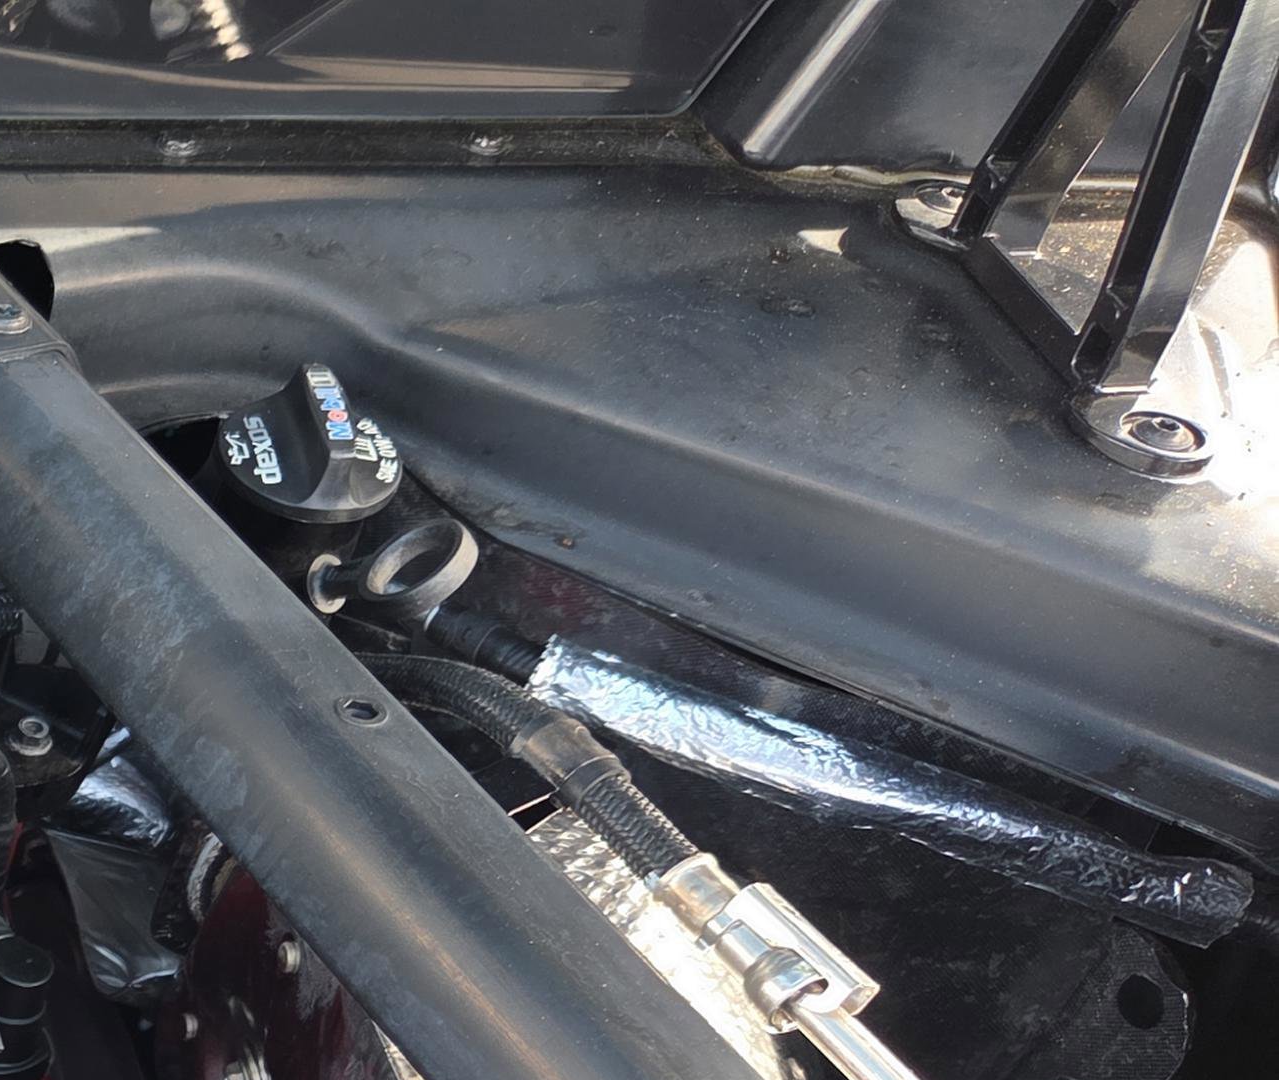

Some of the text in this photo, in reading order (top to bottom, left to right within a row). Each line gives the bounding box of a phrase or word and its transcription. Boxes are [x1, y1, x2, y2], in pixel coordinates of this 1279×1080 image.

[313, 386, 354, 440] Mobil
[243, 416, 282, 484] dexos
[375, 457, 399, 483] SAE
